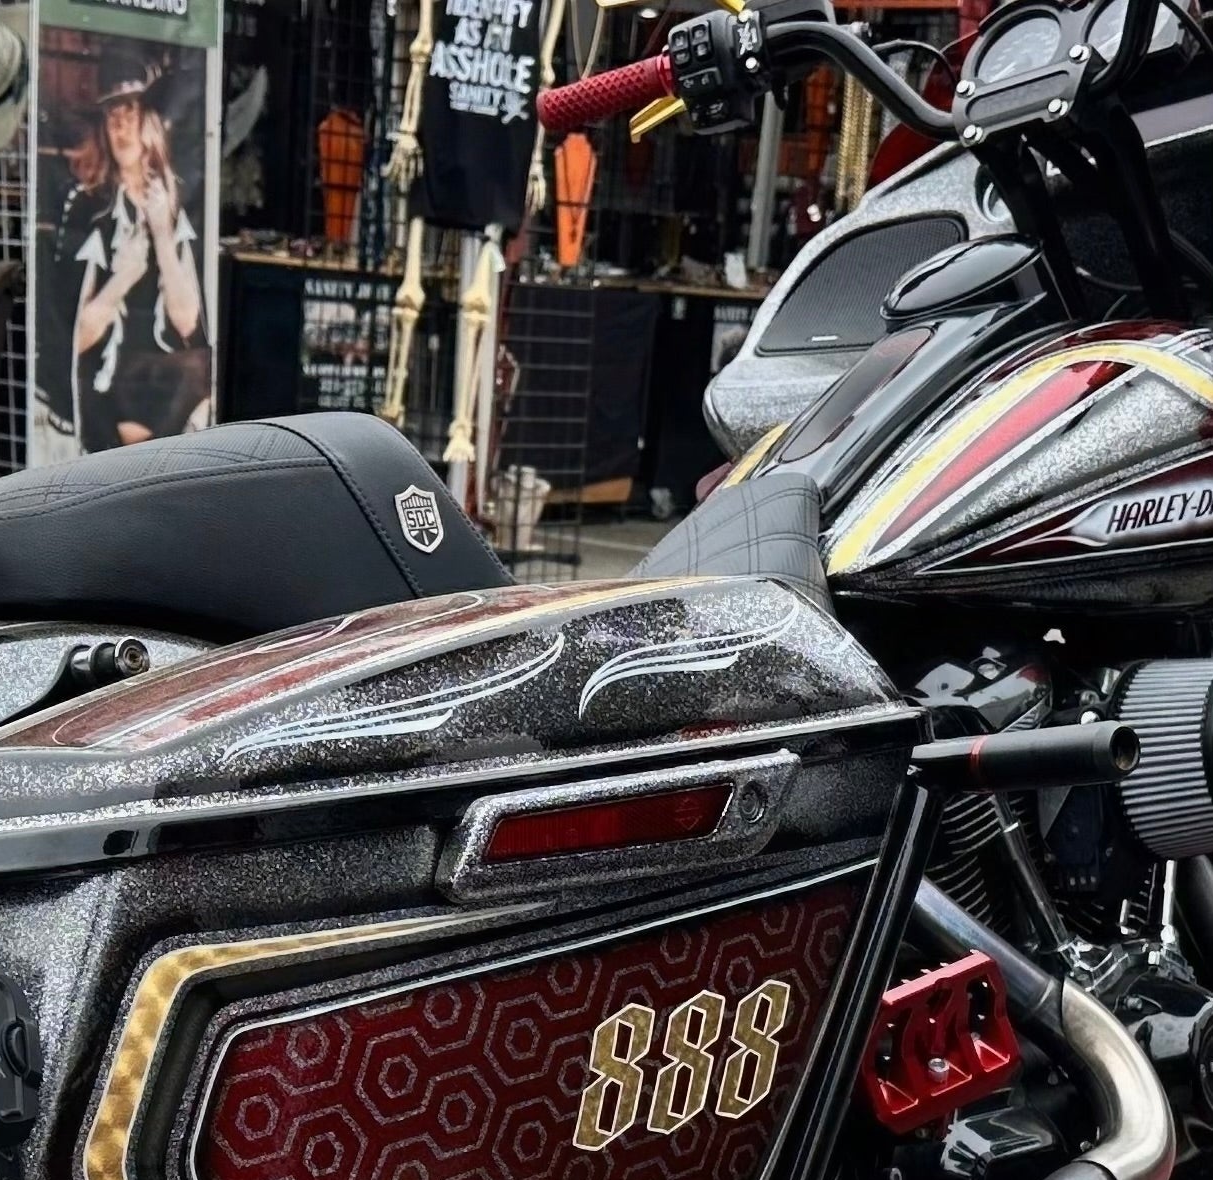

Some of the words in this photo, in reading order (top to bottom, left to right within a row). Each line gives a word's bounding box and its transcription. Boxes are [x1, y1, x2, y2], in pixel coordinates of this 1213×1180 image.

[454, 17, 482, 46] AS
[429, 40, 535, 94] ASSHOLE
[407, 508, 435, 528] SDC
[1105, 489, 1213, 534] HARLEY-D
[572, 979, 791, 1152] 888
